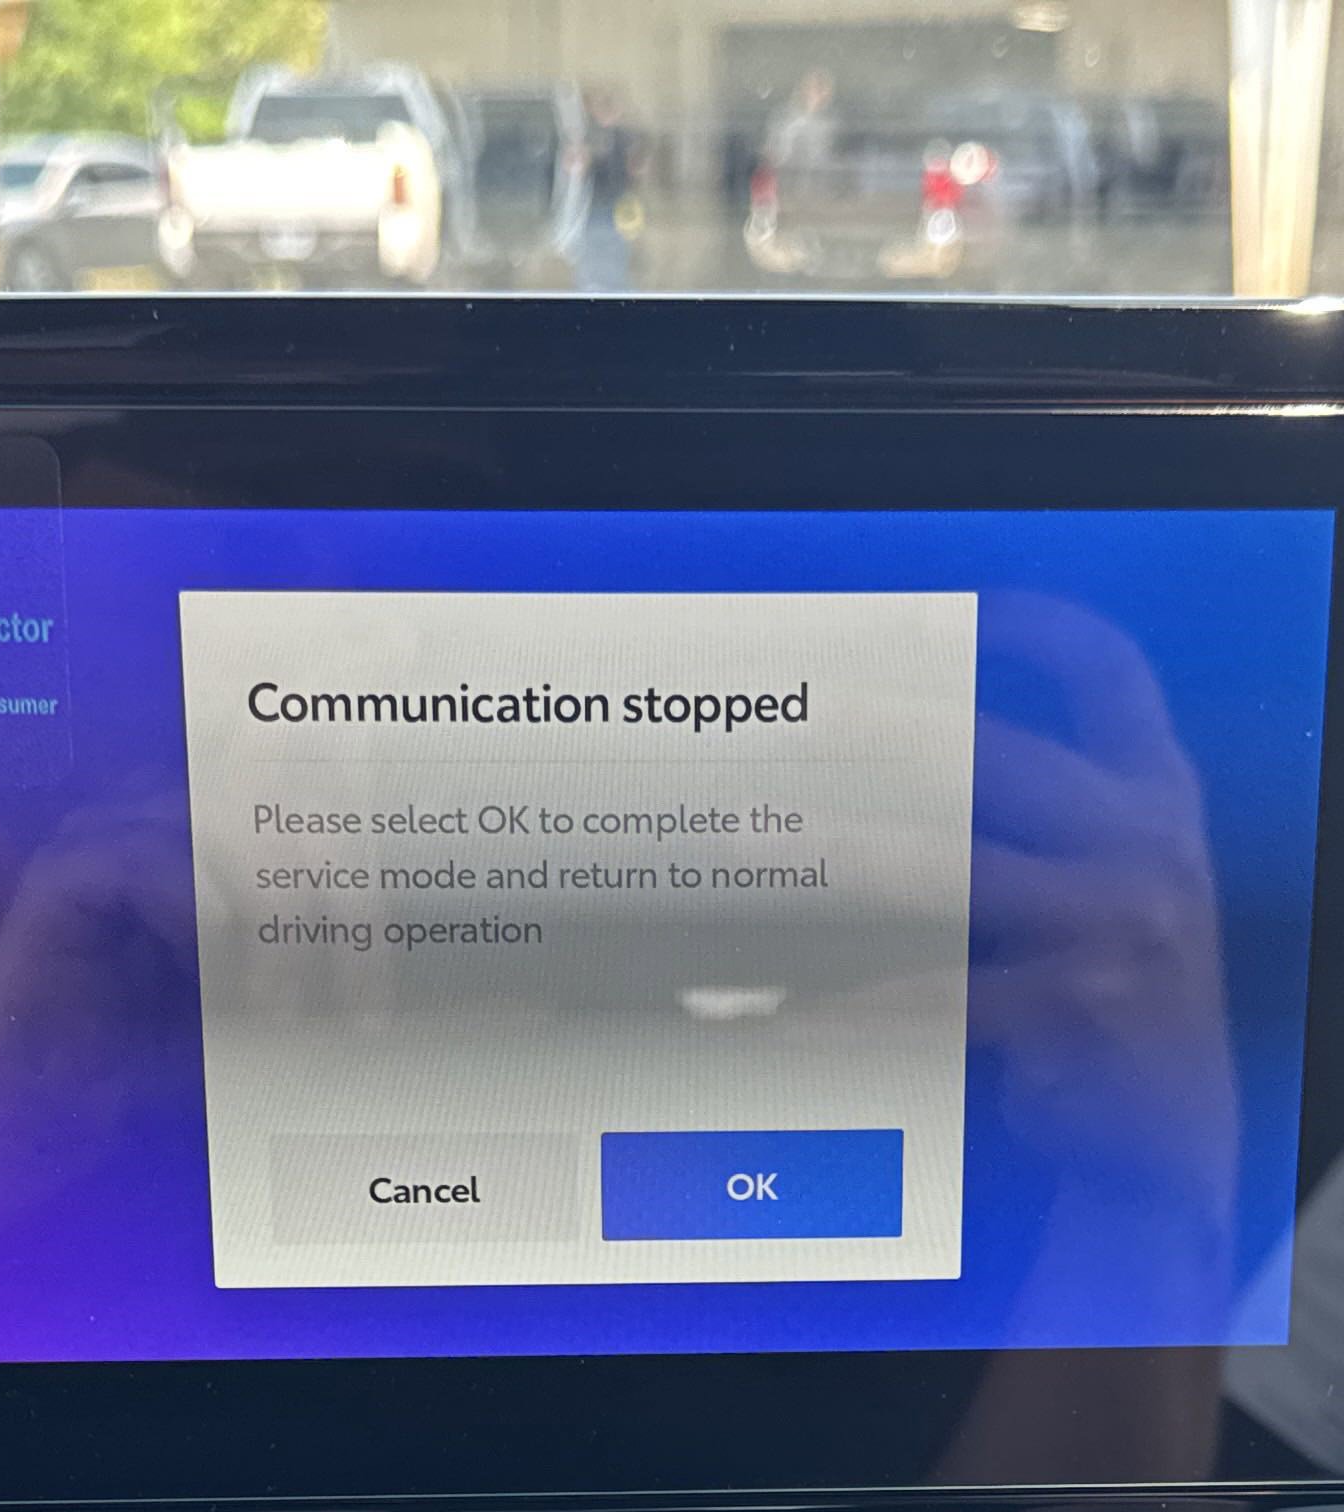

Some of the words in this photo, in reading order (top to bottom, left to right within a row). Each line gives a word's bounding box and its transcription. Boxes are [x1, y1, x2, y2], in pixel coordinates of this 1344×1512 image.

[248, 683, 610, 723] Communication
[622, 681, 809, 732] stopped
[254, 804, 361, 835] Please
[371, 804, 467, 835] select
[478, 805, 530, 835] OK
[539, 808, 574, 835] to
[582, 804, 740, 841] complete
[750, 804, 803, 834] the
[256, 861, 370, 889] service
[380, 860, 476, 889] mode
[486, 860, 547, 889] and
[558, 863, 656, 889] return
[668, 863, 703, 889] to
[712, 859, 829, 889] normal
[259, 914, 372, 951] driving
[384, 916, 542, 950] operation
[369, 1177, 481, 1204] Cancel
[727, 1173, 778, 1201] OK
